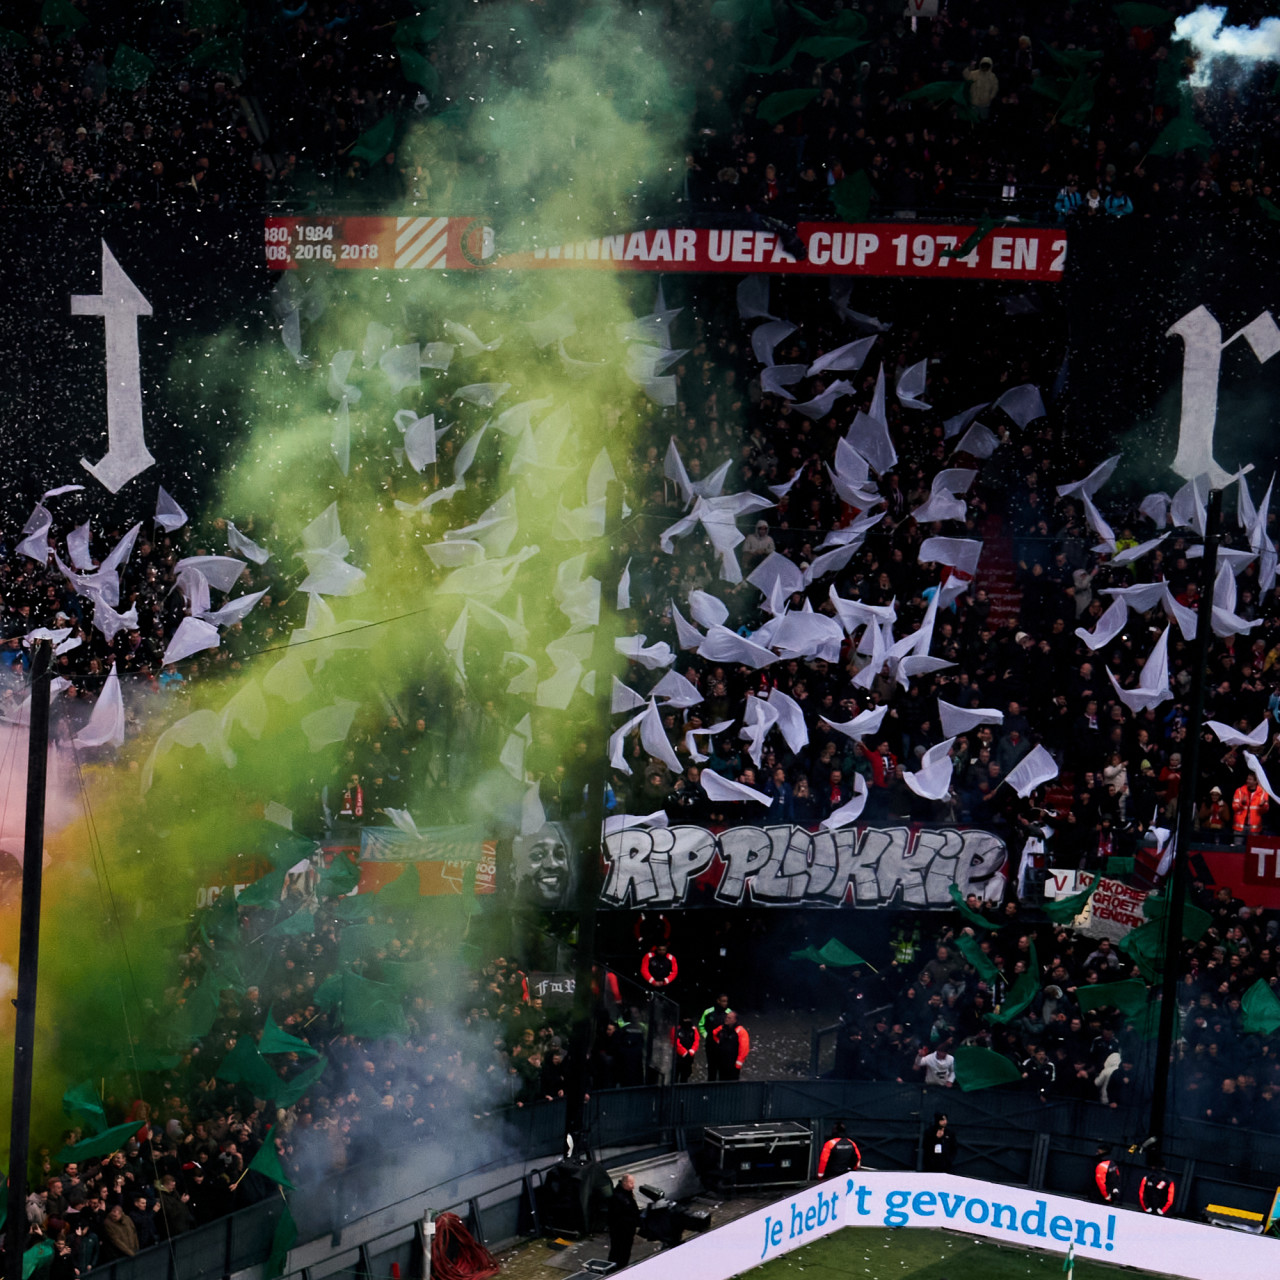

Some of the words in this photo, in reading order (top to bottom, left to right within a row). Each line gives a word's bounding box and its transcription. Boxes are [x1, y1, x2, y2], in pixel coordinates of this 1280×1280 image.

[297, 226, 334, 241] 1984
[295, 244, 337, 261] 2016,
[340, 244, 378, 259] 2018
[534, 229, 696, 261] NNAAR
[707, 230, 797, 263] UEFA
[808, 231, 879, 265] CUP
[991, 236, 1039, 270] EN
[760, 1215, 783, 1259] Je
[789, 1190, 841, 1240] hebt
[845, 1178, 873, 1216] 't
[884, 1190, 1117, 1252] gevonden!
